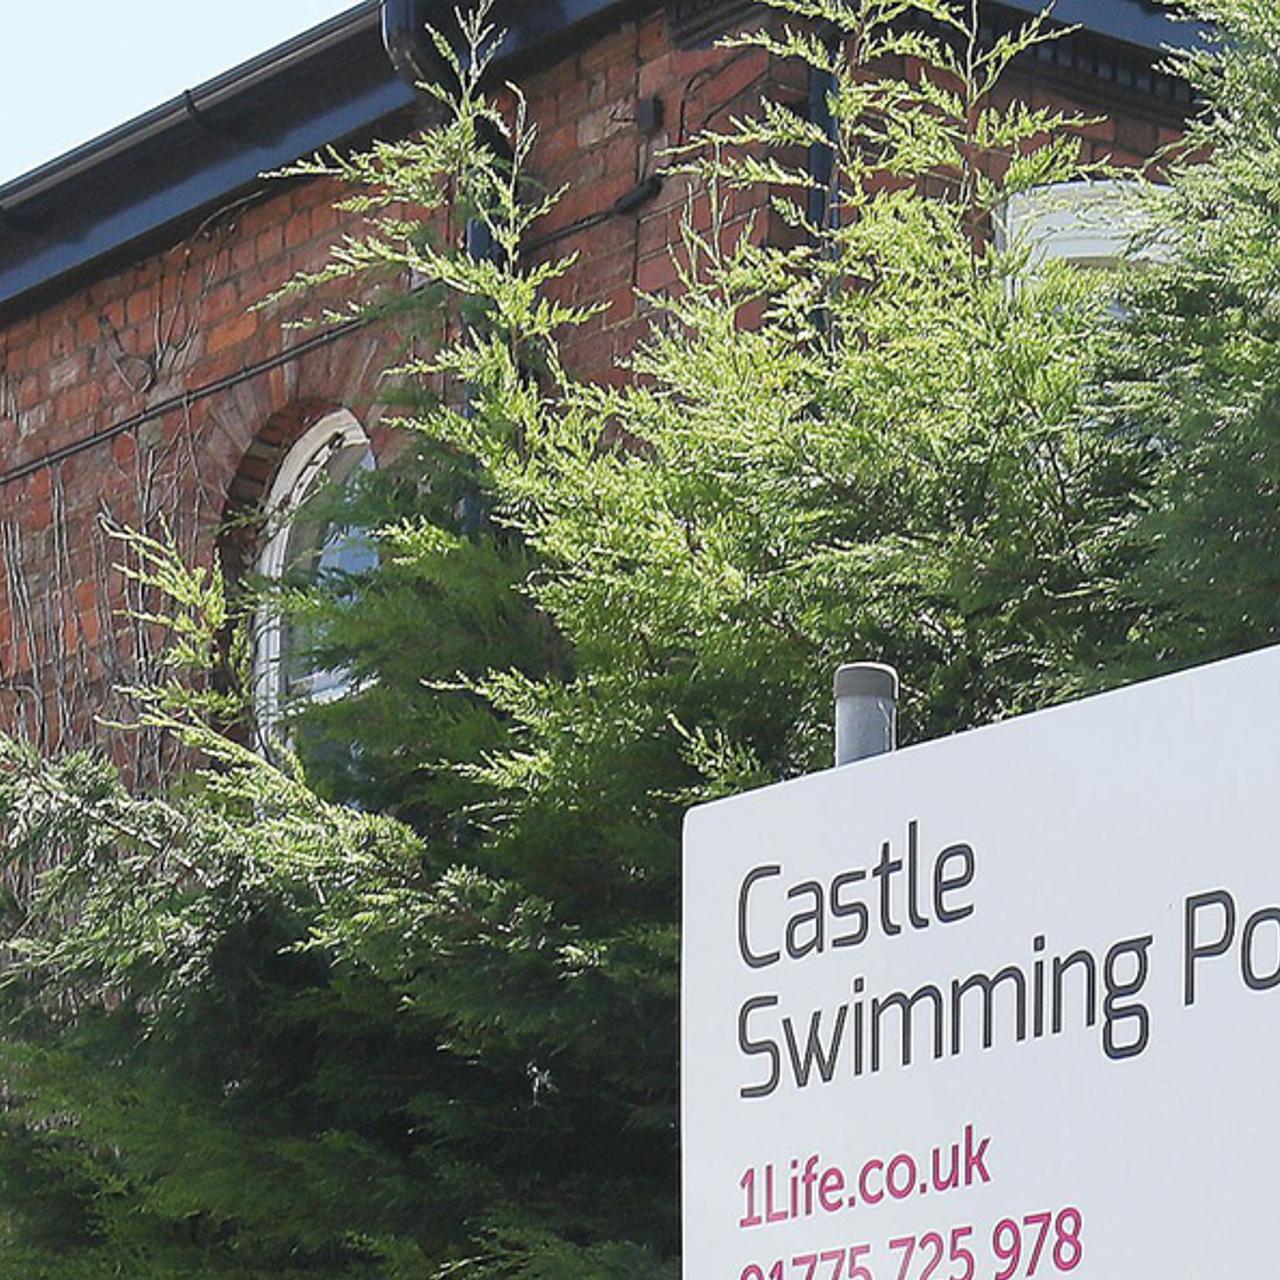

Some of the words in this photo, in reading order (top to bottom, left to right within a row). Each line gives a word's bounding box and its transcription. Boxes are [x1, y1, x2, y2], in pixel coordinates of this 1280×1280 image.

[737, 820, 975, 969] Castle
[738, 934, 1153, 1099] Swimming
[739, 1124, 992, 1227] 1Life.co.uk
